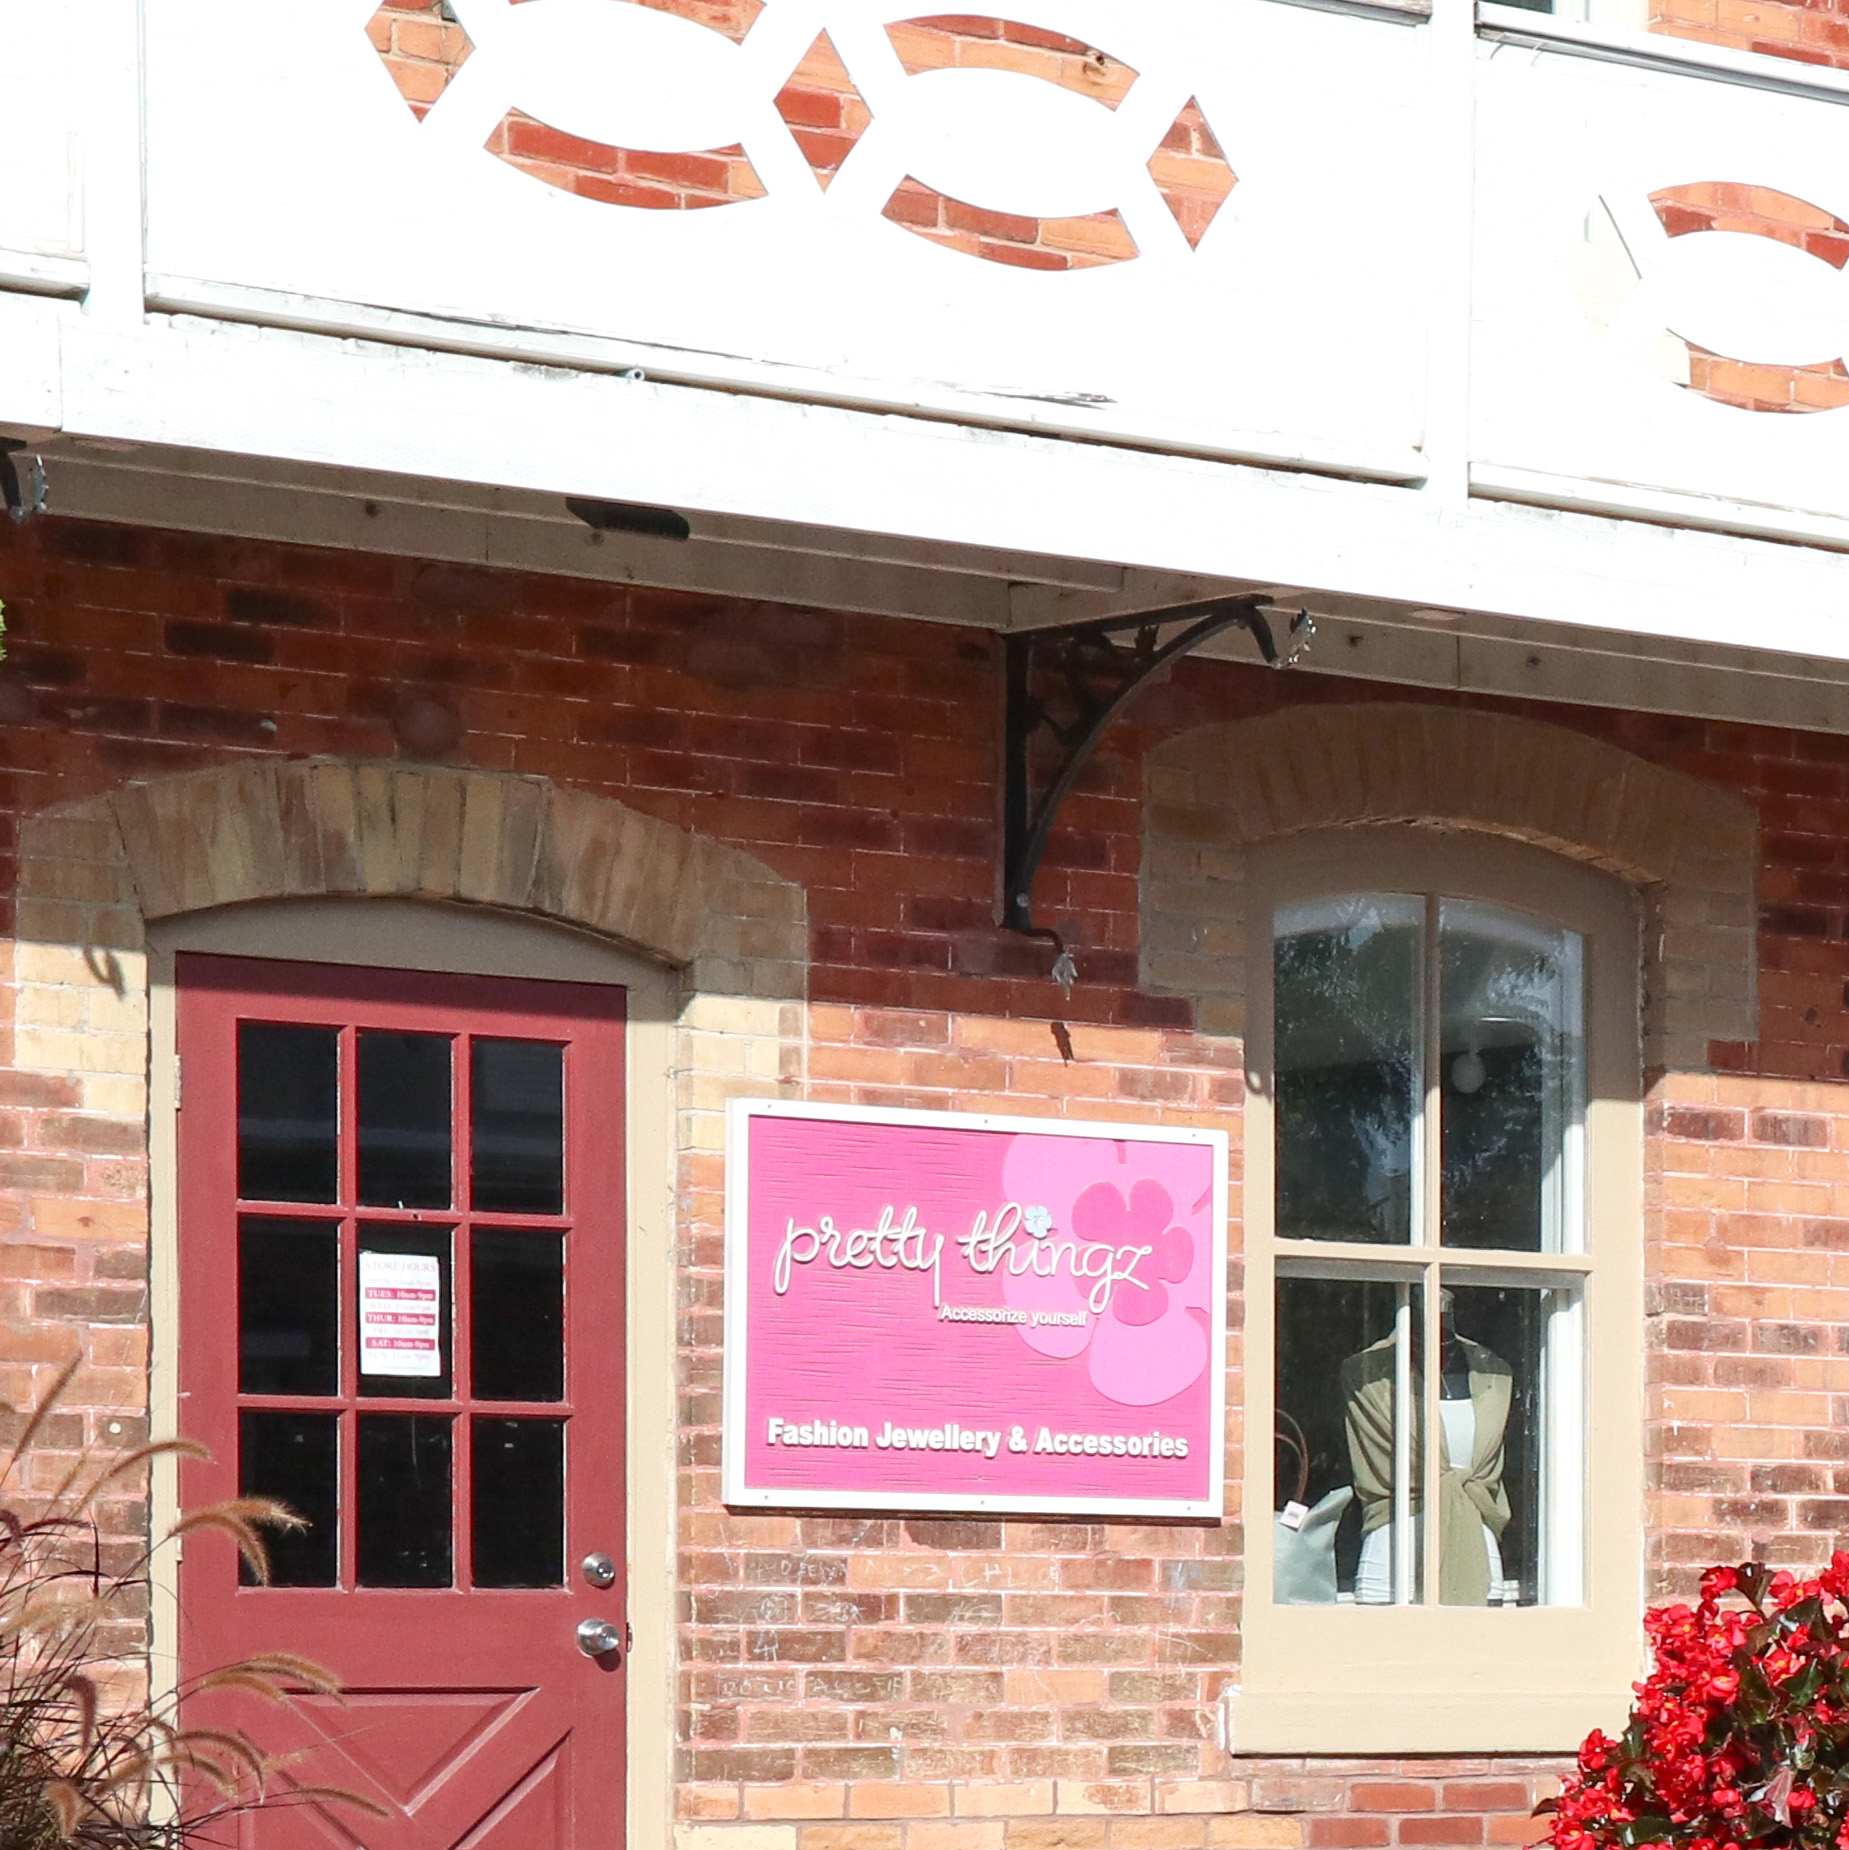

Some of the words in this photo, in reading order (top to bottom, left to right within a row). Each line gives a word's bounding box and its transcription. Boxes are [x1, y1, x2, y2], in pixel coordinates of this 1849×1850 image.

[402, 1262, 436, 1272] HOURS
[774, 1205, 944, 1307] pretty
[957, 1203, 1153, 1314] thingz
[939, 1304, 1027, 1325] Accessorize
[1030, 1308, 1088, 1328] yourself
[767, 1418, 868, 1449] Fashion
[876, 1422, 1000, 1457] Jewellery
[1008, 1426, 1027, 1453] &
[1034, 1428, 1189, 1457] Accessories
